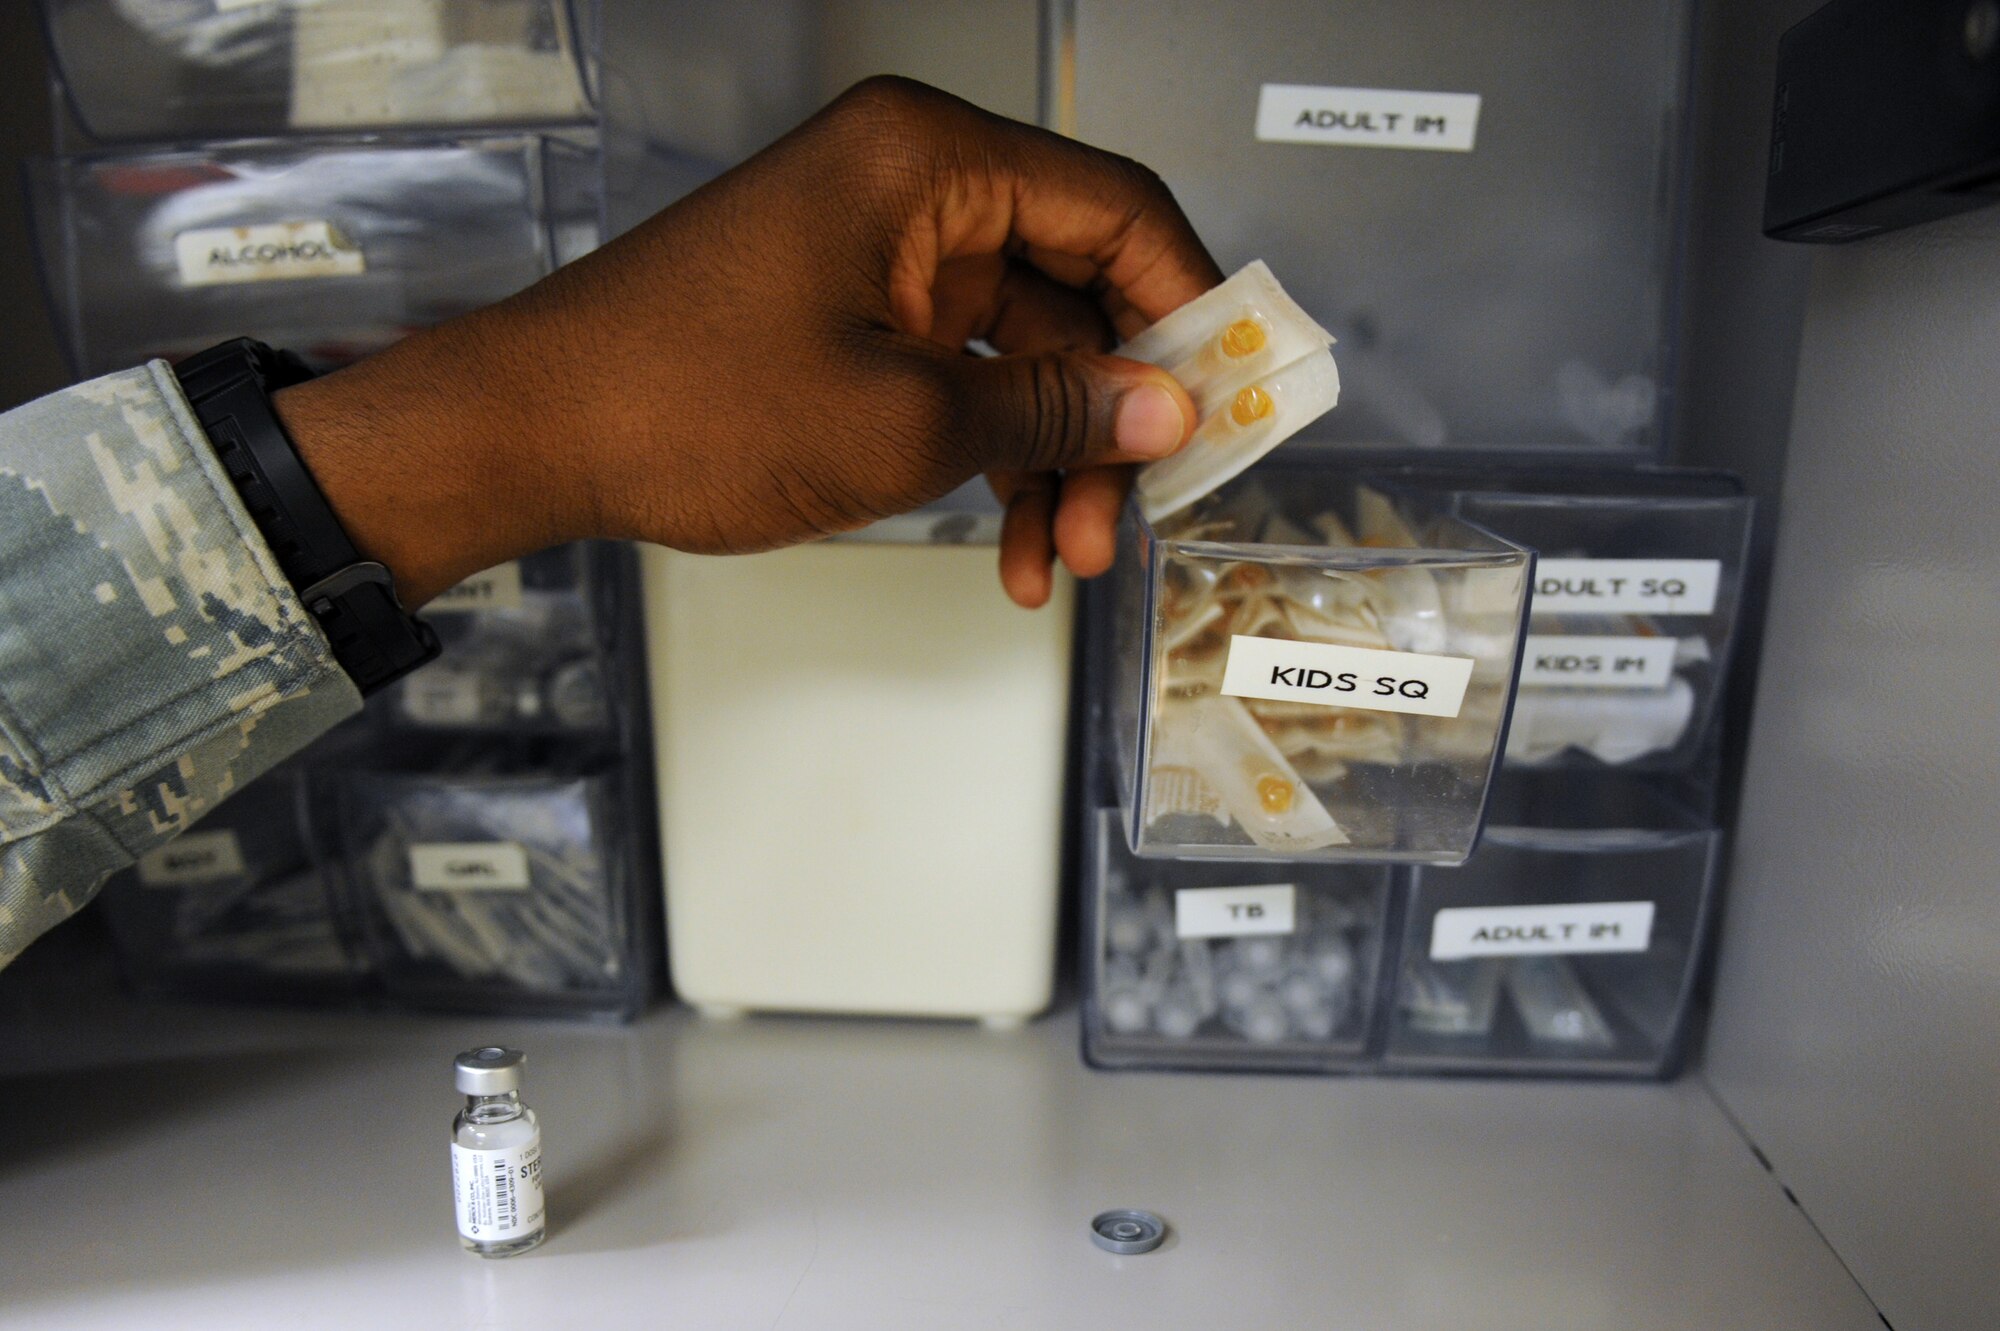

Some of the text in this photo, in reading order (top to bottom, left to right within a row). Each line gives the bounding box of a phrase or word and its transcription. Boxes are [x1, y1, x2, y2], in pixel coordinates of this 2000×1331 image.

[1295, 108, 1446, 134] ADULT IM
[208, 241, 332, 266] ALCOHOL
[1640, 577, 1687, 597] SQ
[1535, 654, 1646, 672] KIDS IM
[1270, 665, 1430, 700] KIDS SQ
[1226, 902, 1266, 921] TB
[1470, 922, 1620, 943] ADULT IM
